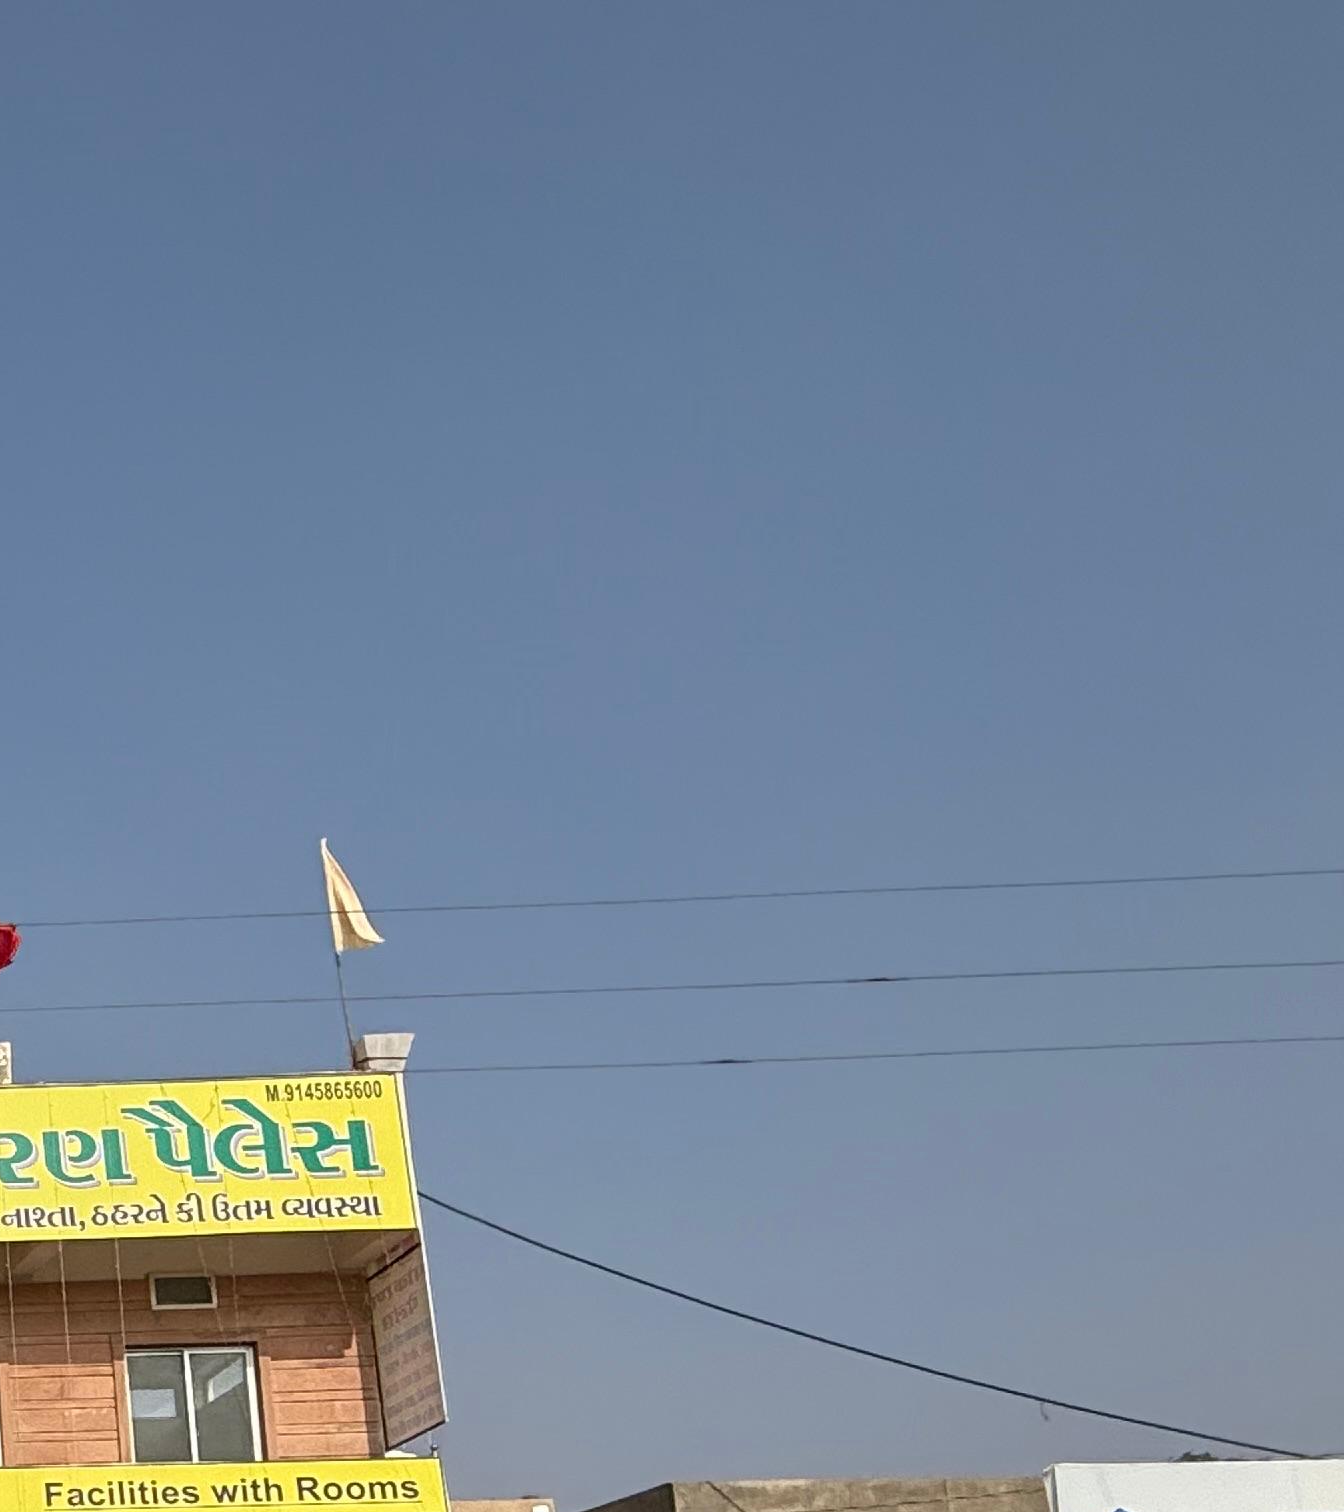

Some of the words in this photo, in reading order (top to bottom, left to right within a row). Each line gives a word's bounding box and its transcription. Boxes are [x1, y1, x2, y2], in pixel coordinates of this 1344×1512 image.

[265, 1080, 382, 1102] M.9145865600
[121, 1099, 383, 1181] પૈલેસ
[176, 1192, 205, 1223] કી
[44, 1480, 200, 1507] Facilities
[211, 1477, 284, 1503] with
[296, 1476, 419, 1501] Rooms
